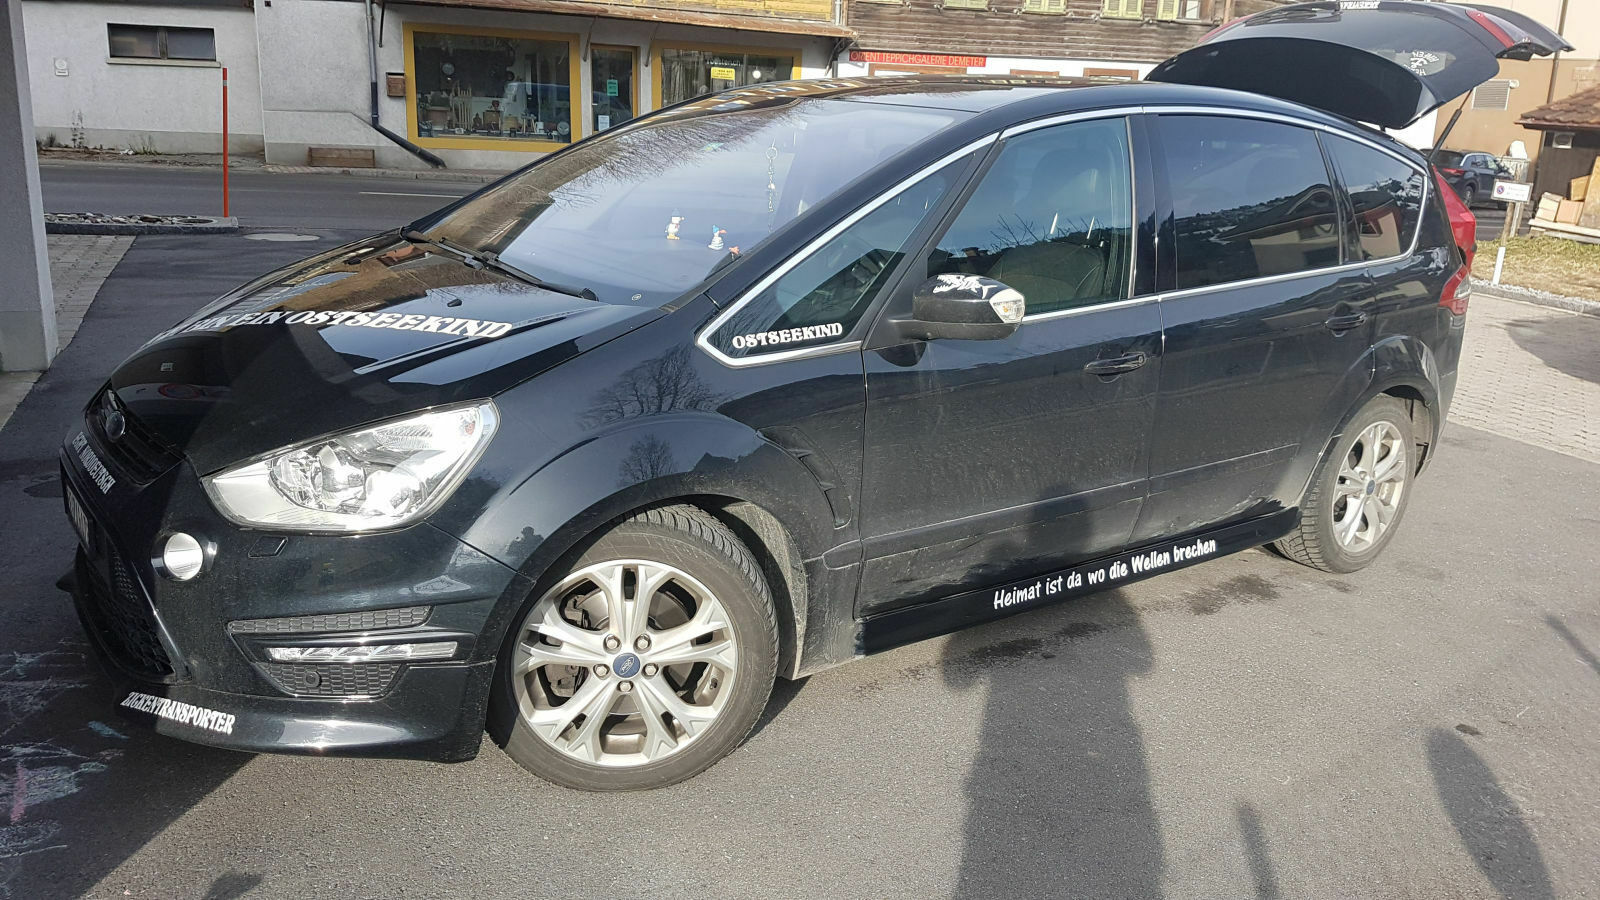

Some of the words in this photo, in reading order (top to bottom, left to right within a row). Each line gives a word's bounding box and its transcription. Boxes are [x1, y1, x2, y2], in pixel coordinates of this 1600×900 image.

[851, 51, 880, 62] ORIENT
[881, 52, 947, 65] TEPPICHGALERIE
[948, 56, 984, 67] DEMETER
[229, 310, 294, 325] EIN
[285, 309, 513, 338] OSTSEEKIND
[732, 322, 843, 349] OSTSEEKIND
[993, 581, 1042, 610] Heimat
[1045, 575, 1063, 595] ist
[1067, 571, 1082, 589] da
[1088, 568, 1106, 585] wo
[1109, 560, 1128, 580] die
[1131, 551, 1171, 574] Wellen
[1173, 538, 1216, 563] brechen
[120, 691, 236, 735] ZICKENTRANSPORTER
